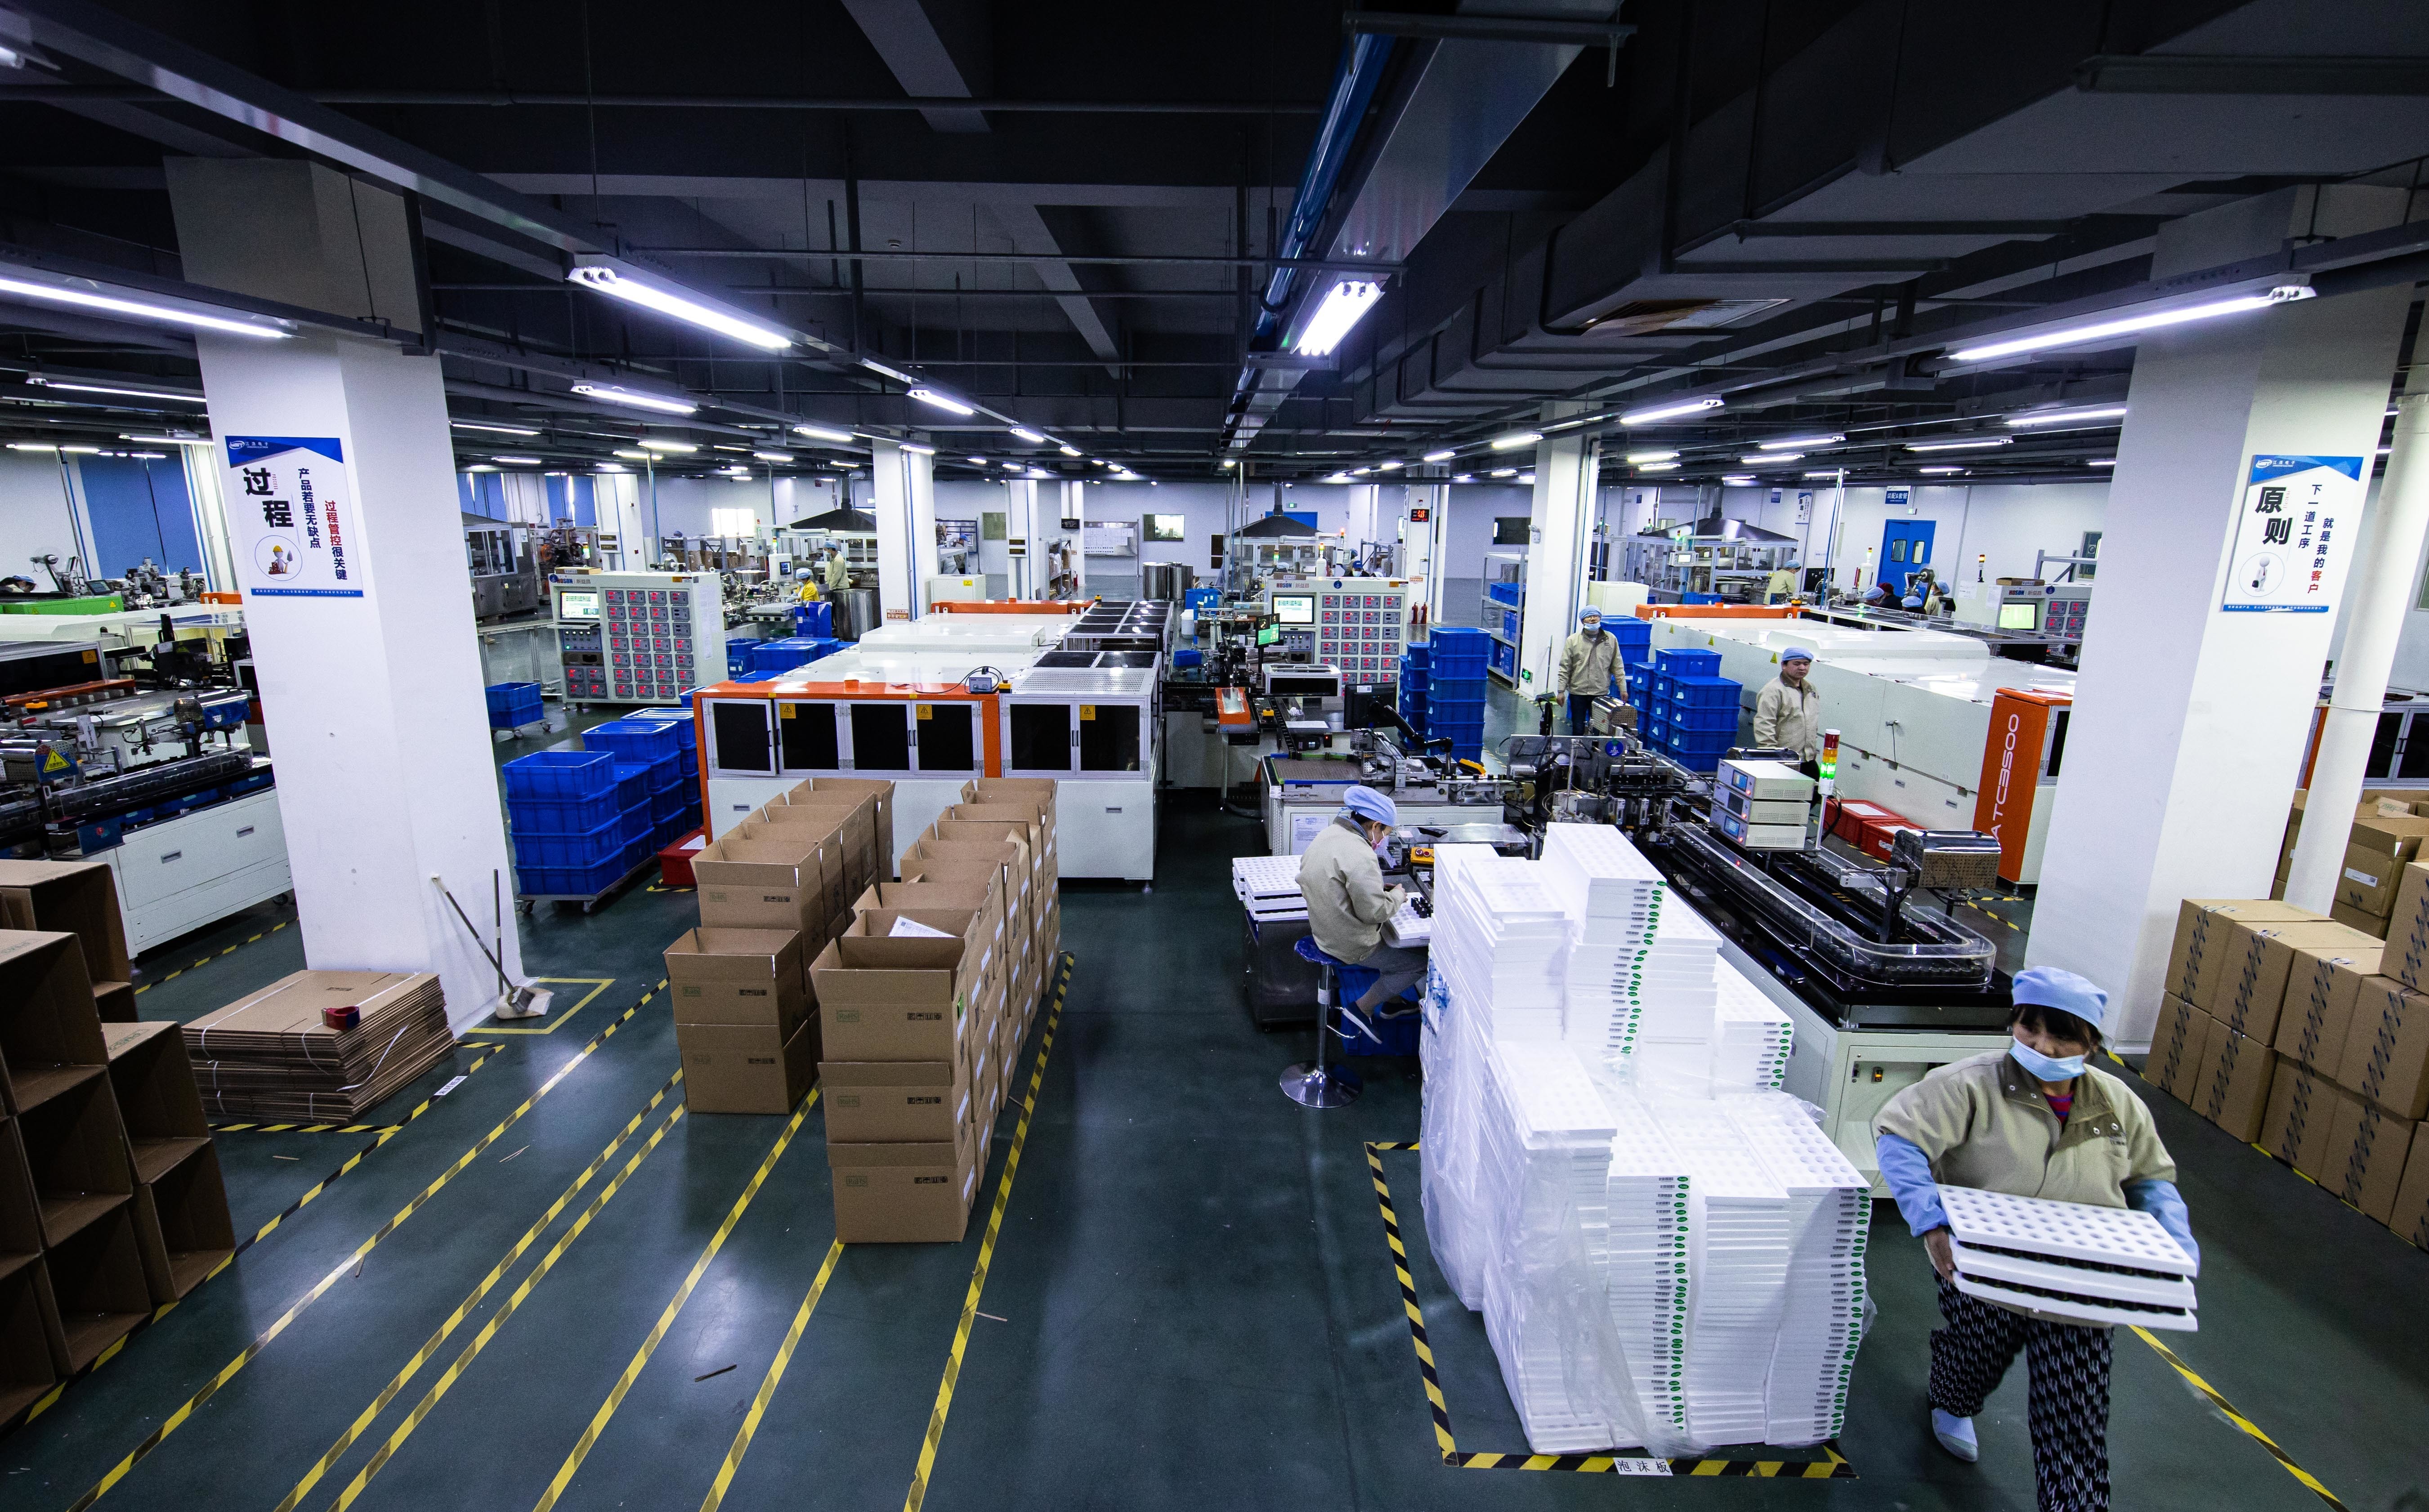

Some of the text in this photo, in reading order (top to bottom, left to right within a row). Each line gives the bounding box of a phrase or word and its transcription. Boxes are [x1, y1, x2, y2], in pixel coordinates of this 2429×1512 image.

[243, 467, 294, 528] 过程
[298, 468, 321, 549] 产品若要无缺点
[2255, 486, 2293, 545] 原则
[2298, 484, 2322, 549] 下一道工序
[325, 500, 348, 580] 过程管控很关键
[2308, 518, 2334, 594] 就是我的客户
[1617, 1460, 1670, 1473] 泡沫板
